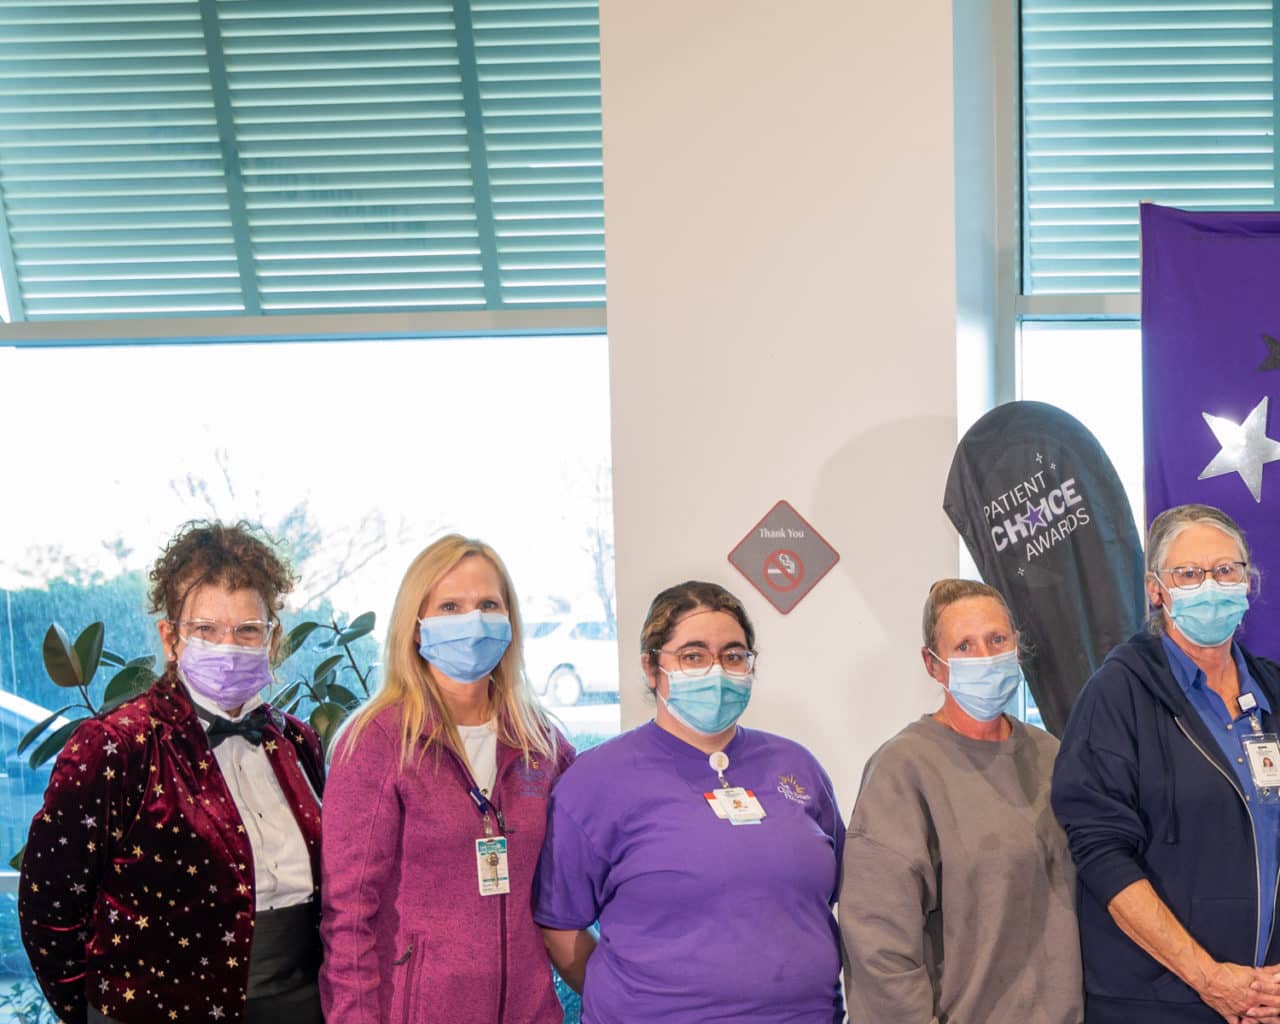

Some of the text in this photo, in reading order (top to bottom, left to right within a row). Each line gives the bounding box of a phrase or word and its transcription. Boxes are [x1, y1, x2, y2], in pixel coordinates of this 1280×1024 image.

[983, 470, 1047, 525] PATIENT
[759, 527, 805, 539] Thank You
[1026, 507, 1090, 562] AWARDS
